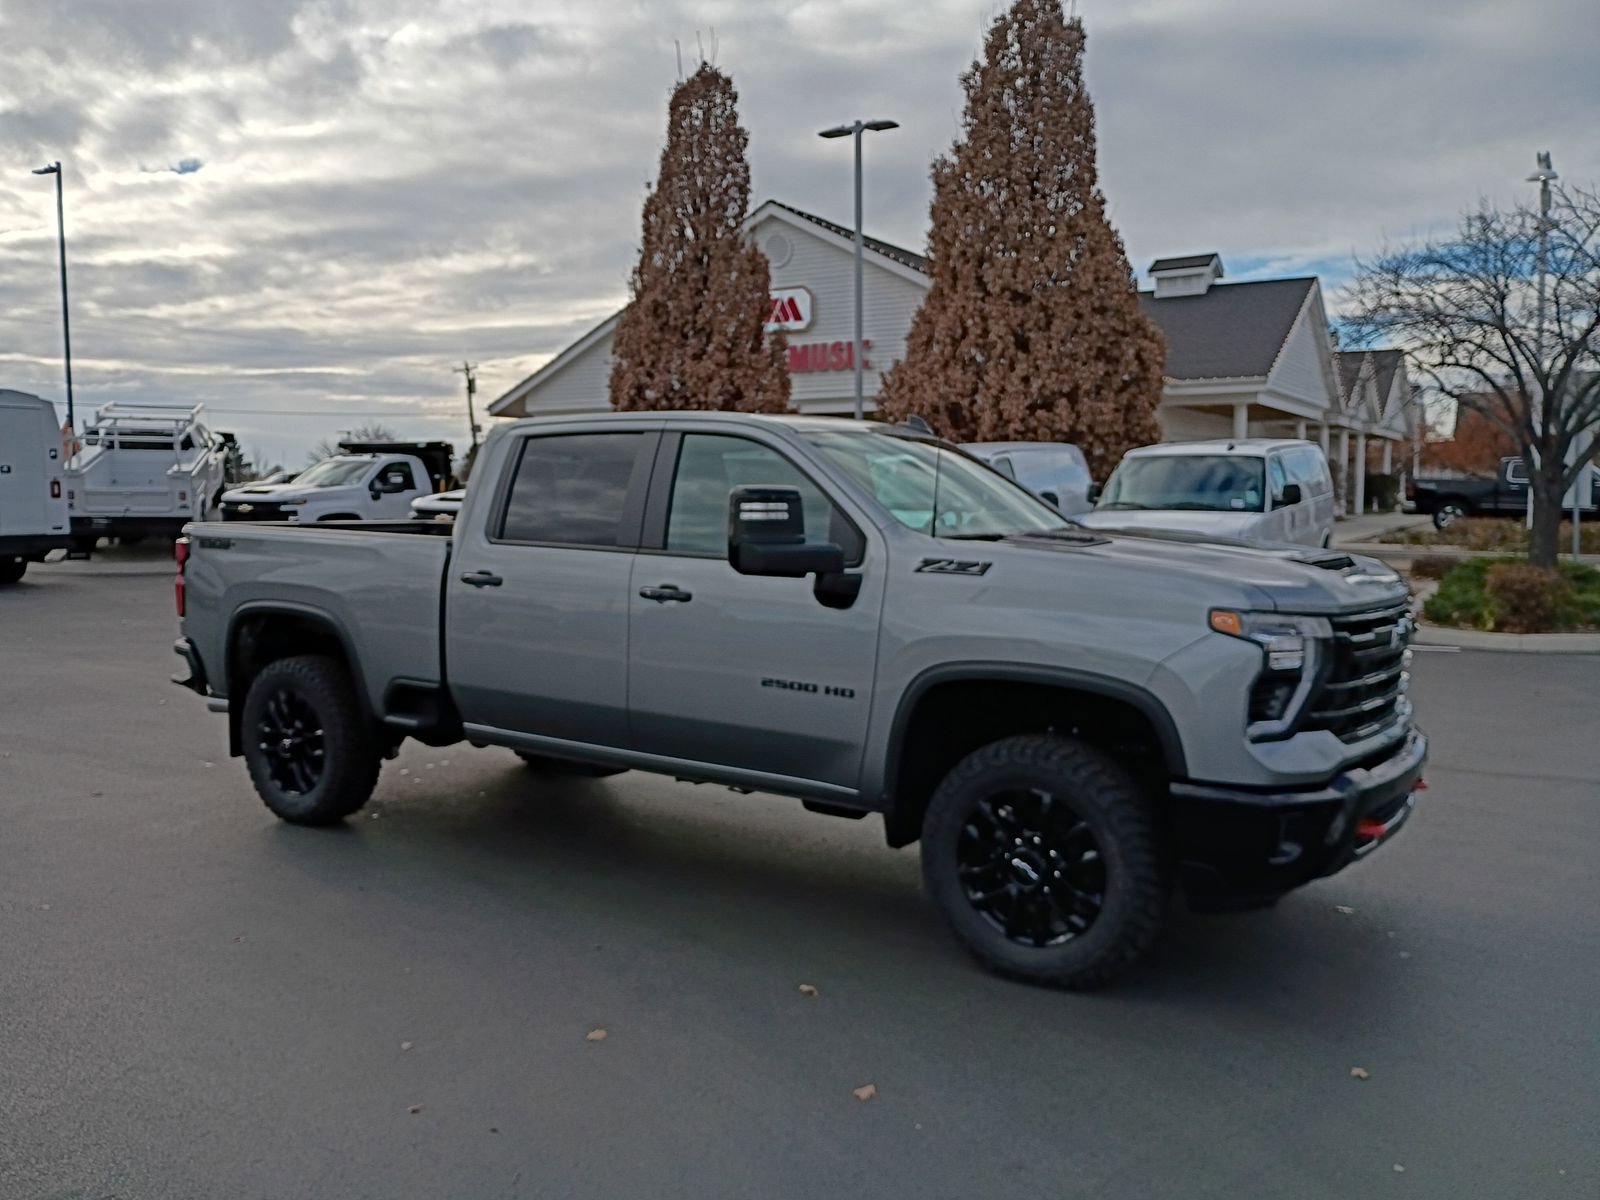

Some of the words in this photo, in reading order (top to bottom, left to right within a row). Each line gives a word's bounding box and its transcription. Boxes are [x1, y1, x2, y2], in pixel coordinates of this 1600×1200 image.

[913, 558, 993, 576] Z71
[761, 678, 818, 693] 2500
[824, 686, 855, 698] HD
